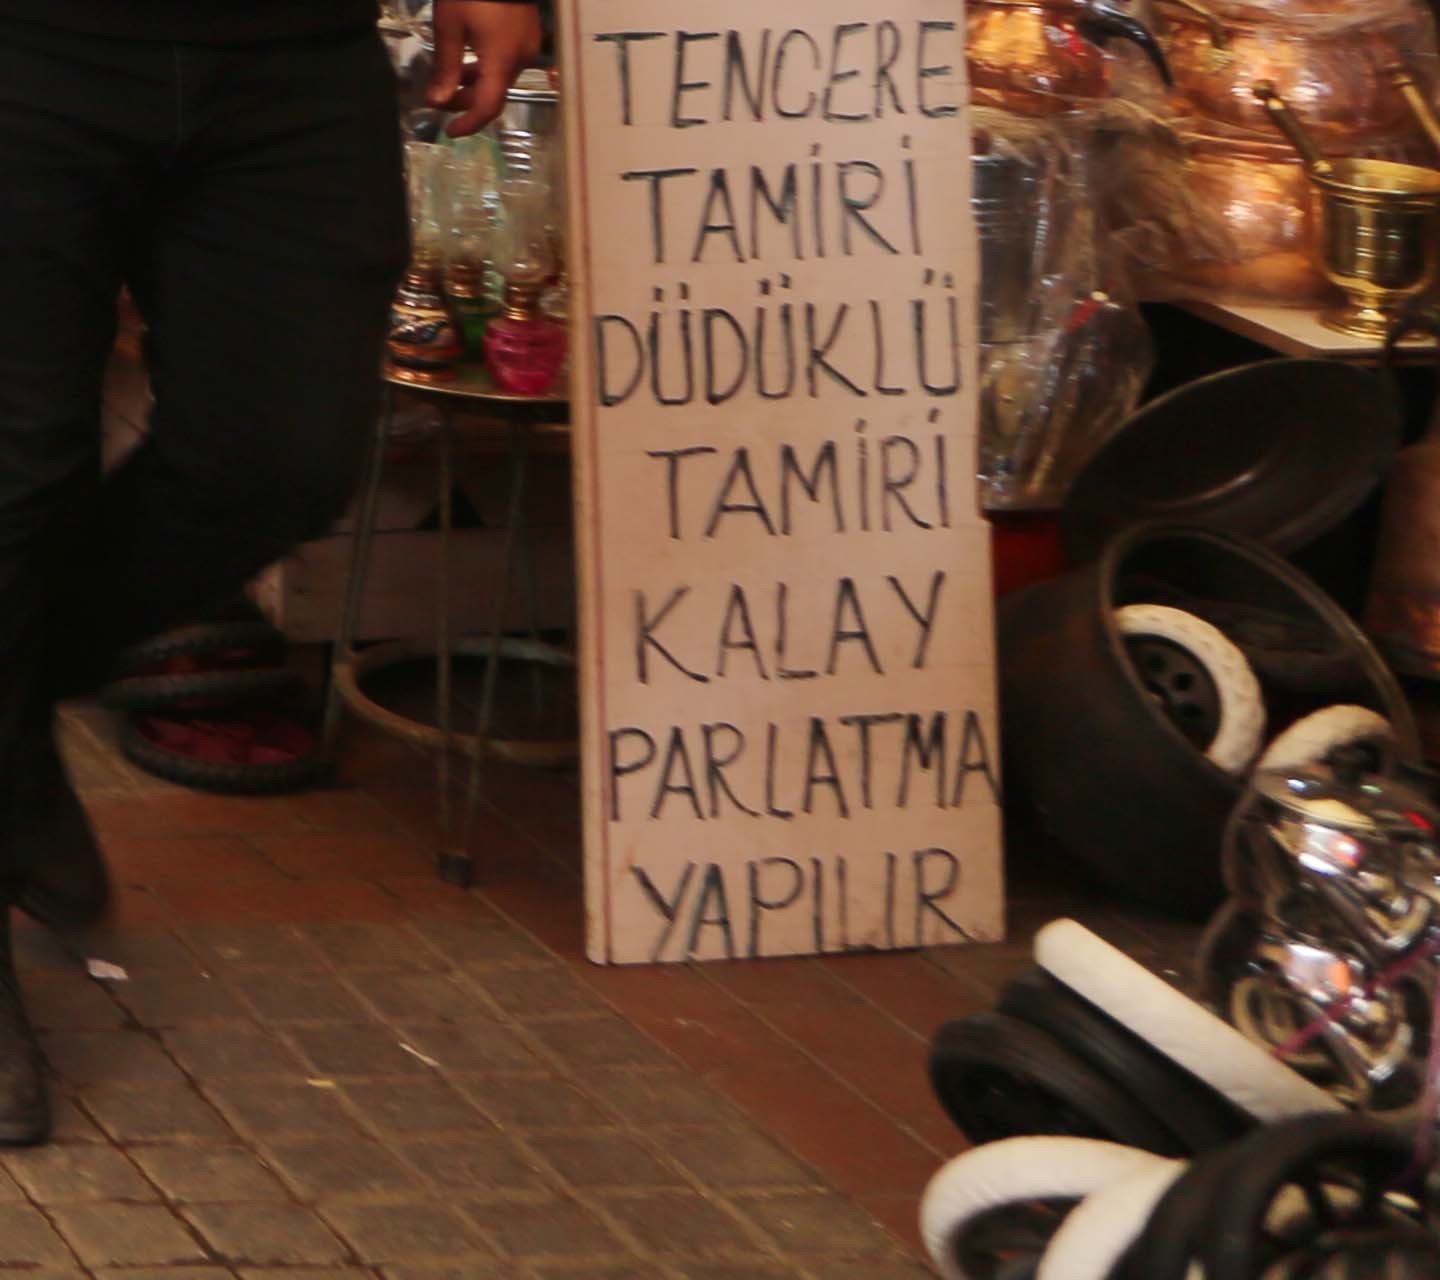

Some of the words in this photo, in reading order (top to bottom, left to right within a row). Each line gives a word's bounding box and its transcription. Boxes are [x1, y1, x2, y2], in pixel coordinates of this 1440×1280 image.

[593, 20, 958, 129] TENCERE
[621, 134, 923, 264] TAMİRİ
[595, 267, 962, 407] DÜDÜKLÜ
[646, 407, 952, 540] TAMİRİ
[633, 570, 947, 685] KALAY
[607, 709, 1002, 821] PARLATMA
[630, 847, 977, 962] YAPILIR
